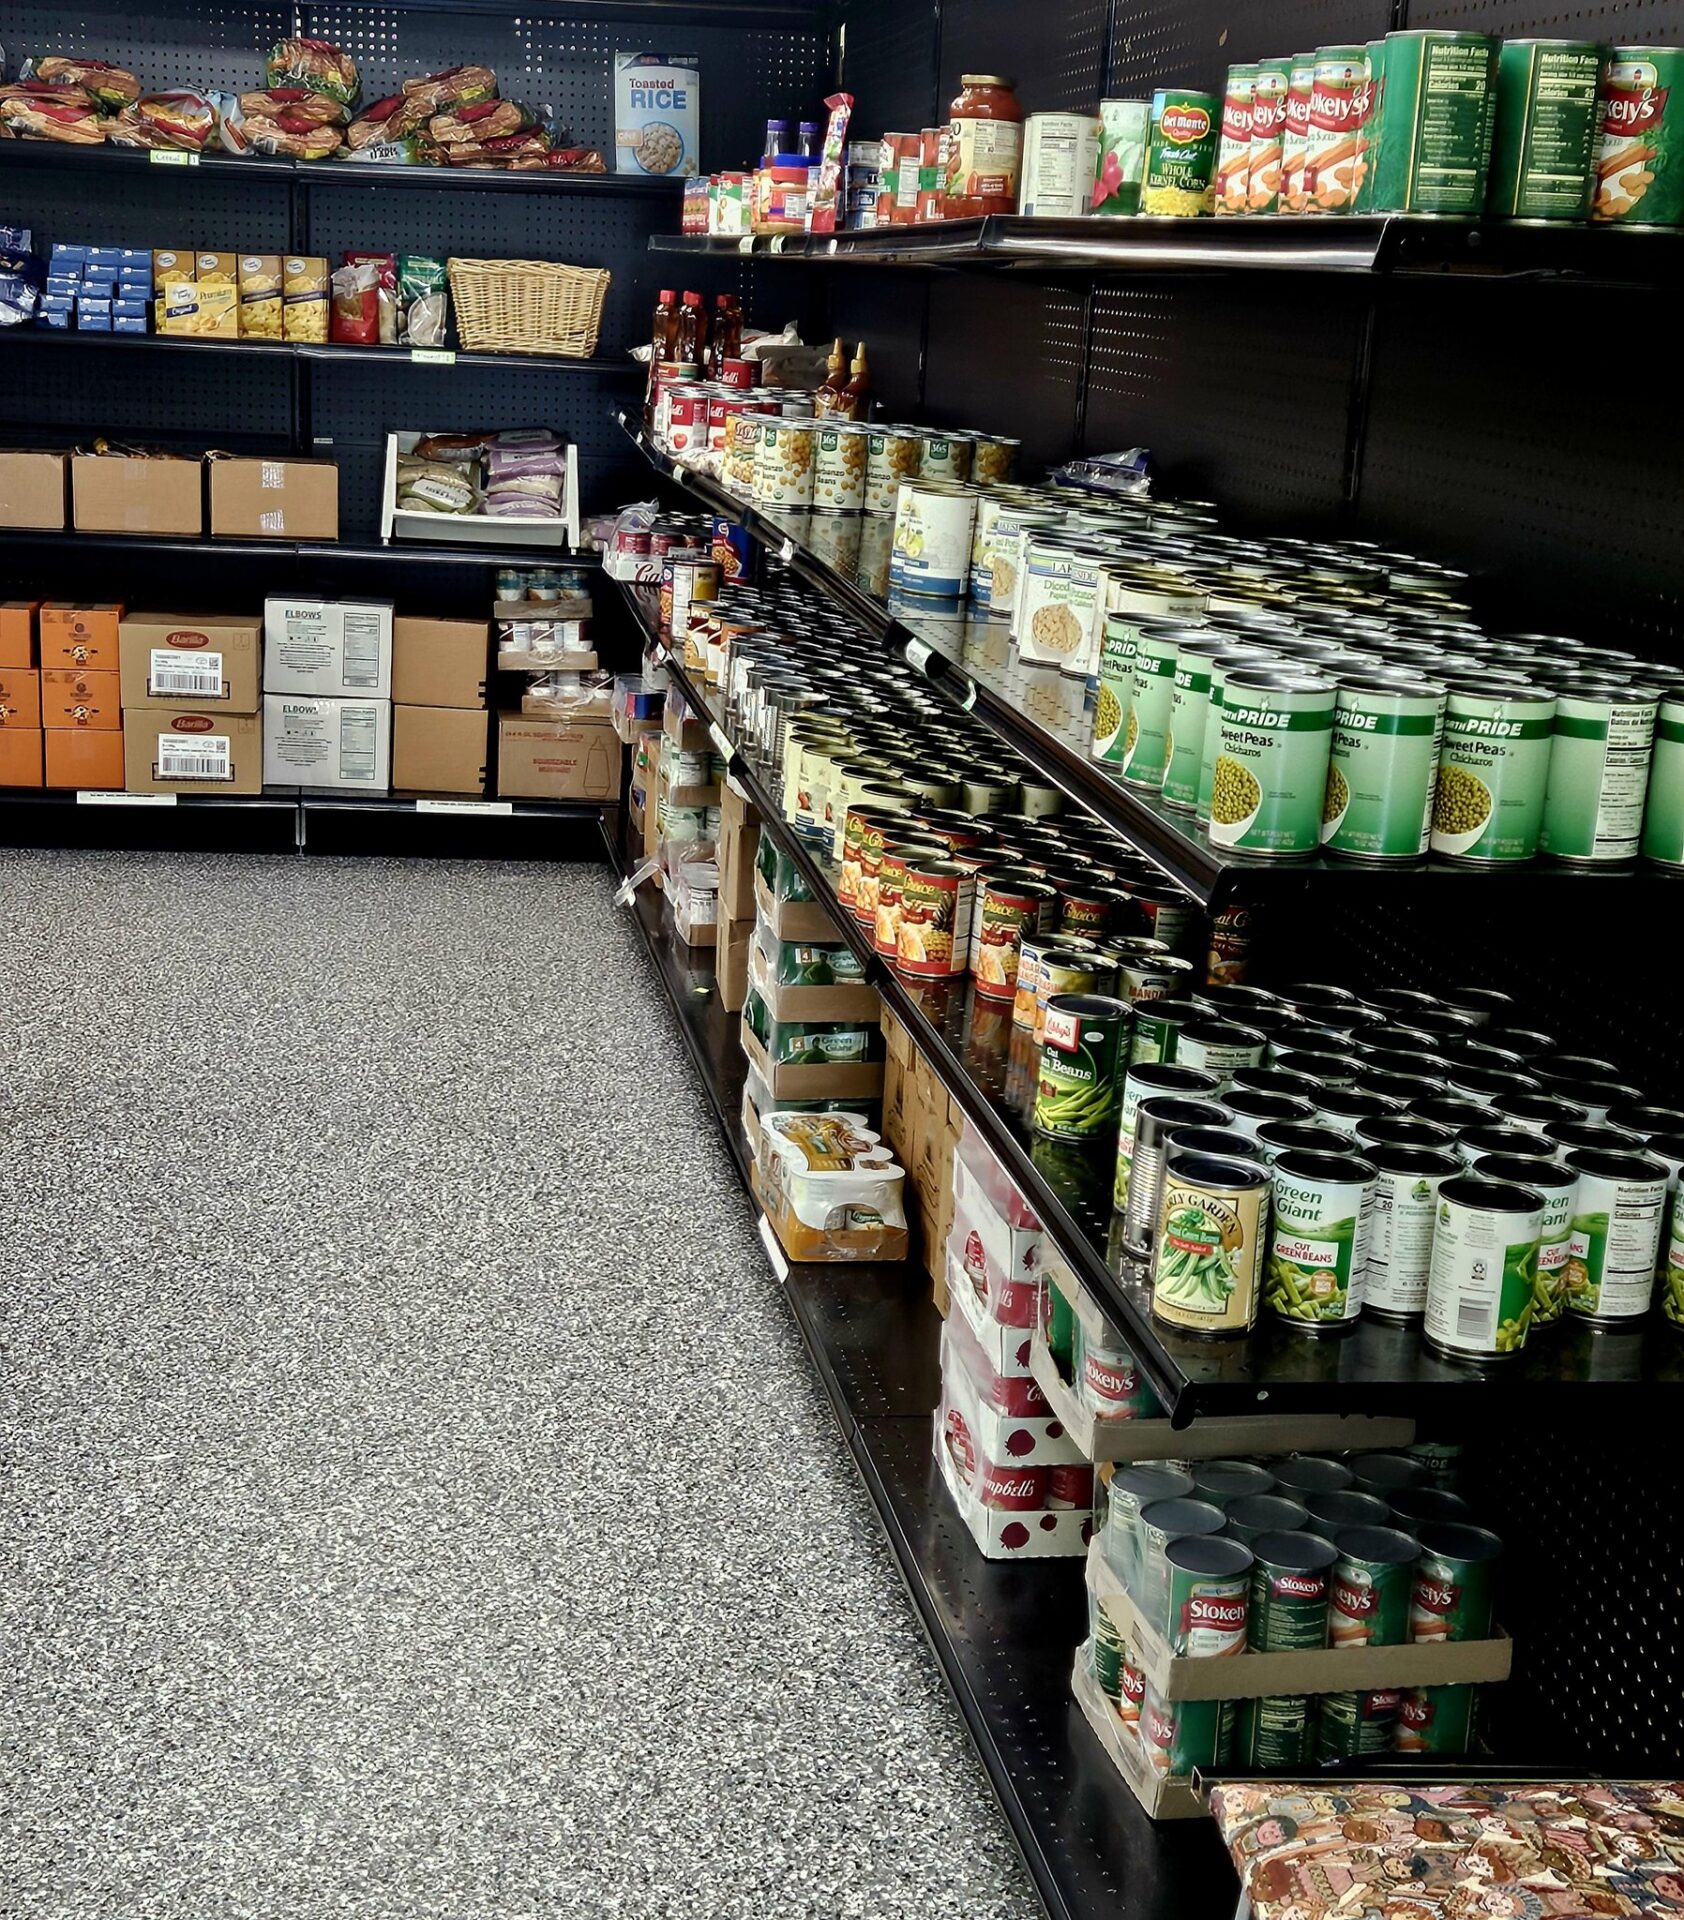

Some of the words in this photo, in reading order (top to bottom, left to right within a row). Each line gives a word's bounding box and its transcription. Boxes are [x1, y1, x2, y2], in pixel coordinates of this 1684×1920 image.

[1432, 46, 1469, 57] Nutrition
[1541, 53, 1579, 64] Nutrition
[1580, 55, 1599, 65] Facts
[629, 78, 674, 90] Toasted
[1475, 80, 1486, 91] 20
[1539, 88, 1568, 98] Calories
[1585, 88, 1595, 98] 20
[631, 90, 686, 110] RICE
[1163, 115, 1176, 127] Del
[1177, 117, 1207, 130] Monte
[1162, 163, 1193, 178] WHOLE
[822, 434, 836, 445] 365
[931, 444, 947, 453] 365
[285, 609, 322, 620] ELBOWS
[171, 634, 205, 645] Barilla
[1108, 640, 1137, 656] PRID
[1112, 660, 1133, 675] Peas
[176, 719, 209, 730] Barilla
[1237, 708, 1291, 728] PRIDE
[1335, 710, 1378, 730] PRIDE
[1466, 718, 1523, 737] PRIDE
[1245, 731, 1274, 748] Peas
[1338, 735, 1361, 748] Peas
[1475, 741, 1506, 757] Peas
[1063, 902, 1100, 923] Choice
[802, 952, 809, 960] 4
[821, 1036, 852, 1044] Green
[1046, 1047, 1059, 1058] Cut
[1052, 1059, 1092, 1081] Beans
[1275, 1178, 1323, 1204] Green
[1618, 1185, 1649, 1194] Nutrition
[1277, 1197, 1323, 1223] Giant
[1382, 1201, 1393, 1210] 20
[1188, 1194, 1238, 1237] GARDEN
[1276, 1244, 1302, 1258] GREEN
[1302, 1251, 1333, 1263] BEANS
[1294, 1242, 1311, 1252] CUT
